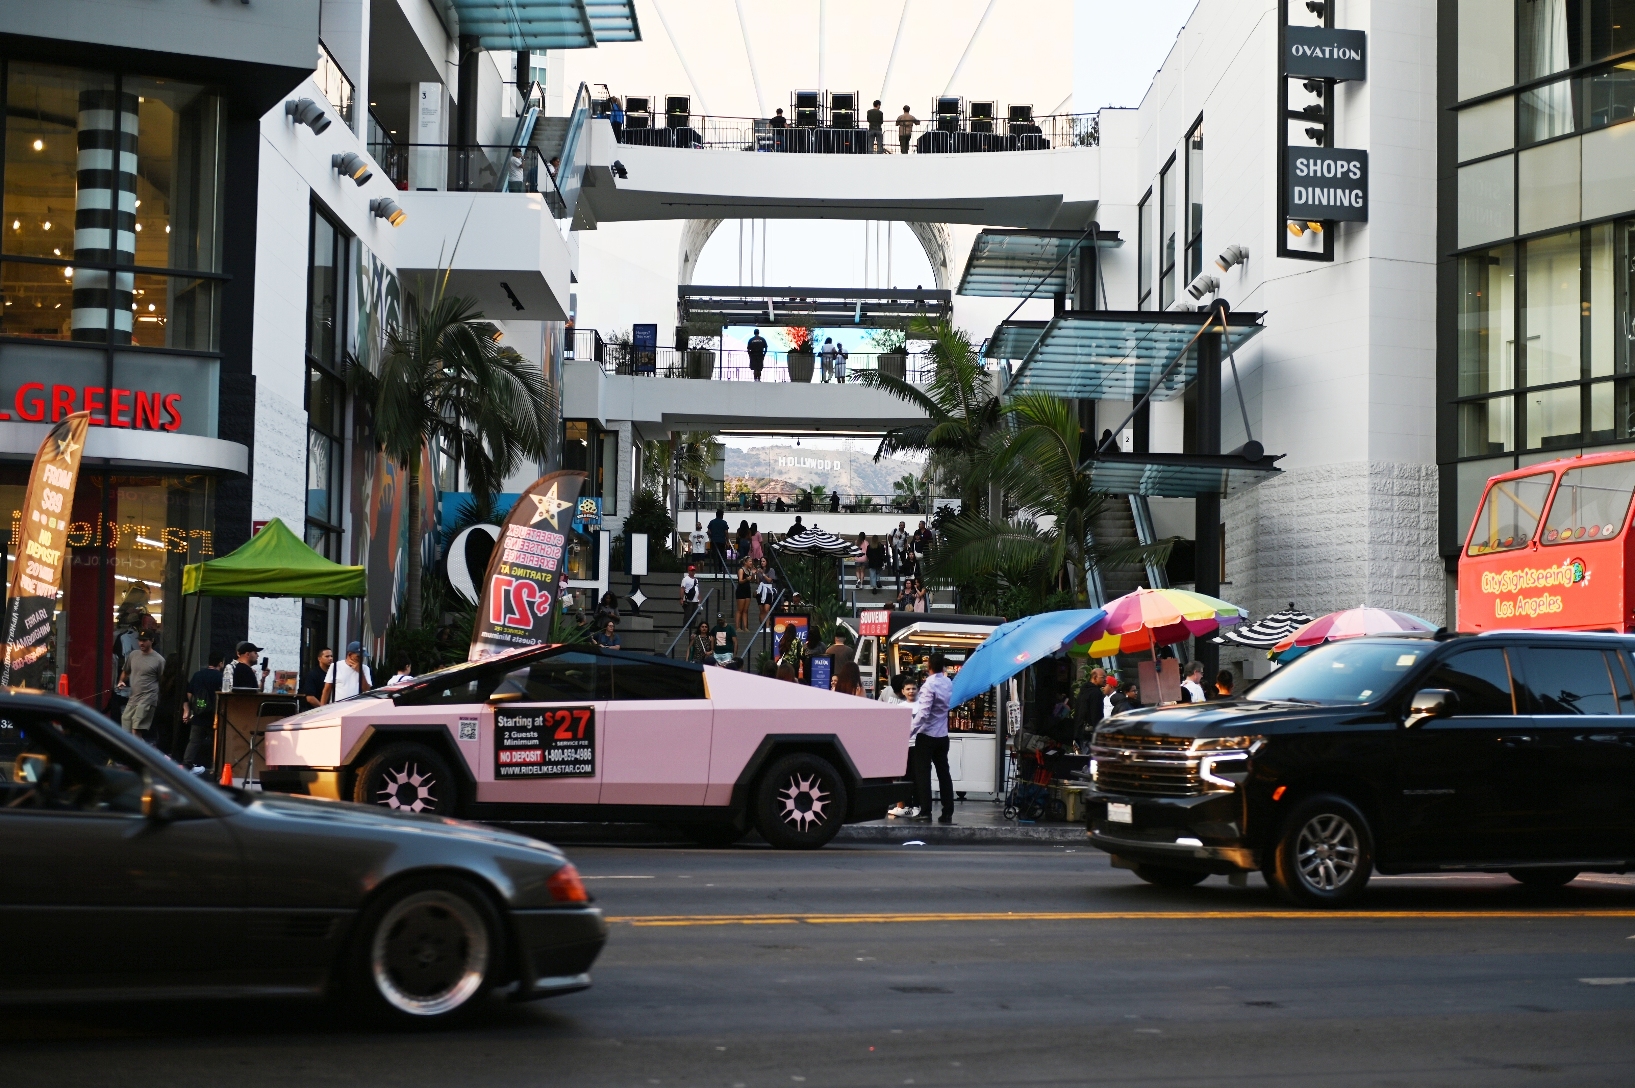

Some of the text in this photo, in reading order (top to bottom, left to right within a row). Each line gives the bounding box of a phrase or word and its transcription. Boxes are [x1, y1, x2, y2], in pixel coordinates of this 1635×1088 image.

[1296, 158, 1361, 179] SHOPS
[1294, 187, 1363, 208] DINING
[778, 456, 841, 471] HOLLYWOOD
[42, 464, 73, 490] FROM
[26, 539, 61, 566] DEPOSIT
[1495, 593, 1562, 618] Los Angeles
[860, 611, 888, 624] SOUVENIR
[498, 710, 591, 740] Starting at $27
[504, 738, 539, 746] Minimum
[500, 748, 592, 762] NO DEPOSIT 1-800-859-4986
[500, 764, 592, 775] WWW.RIDELIKEASTAR.COM
